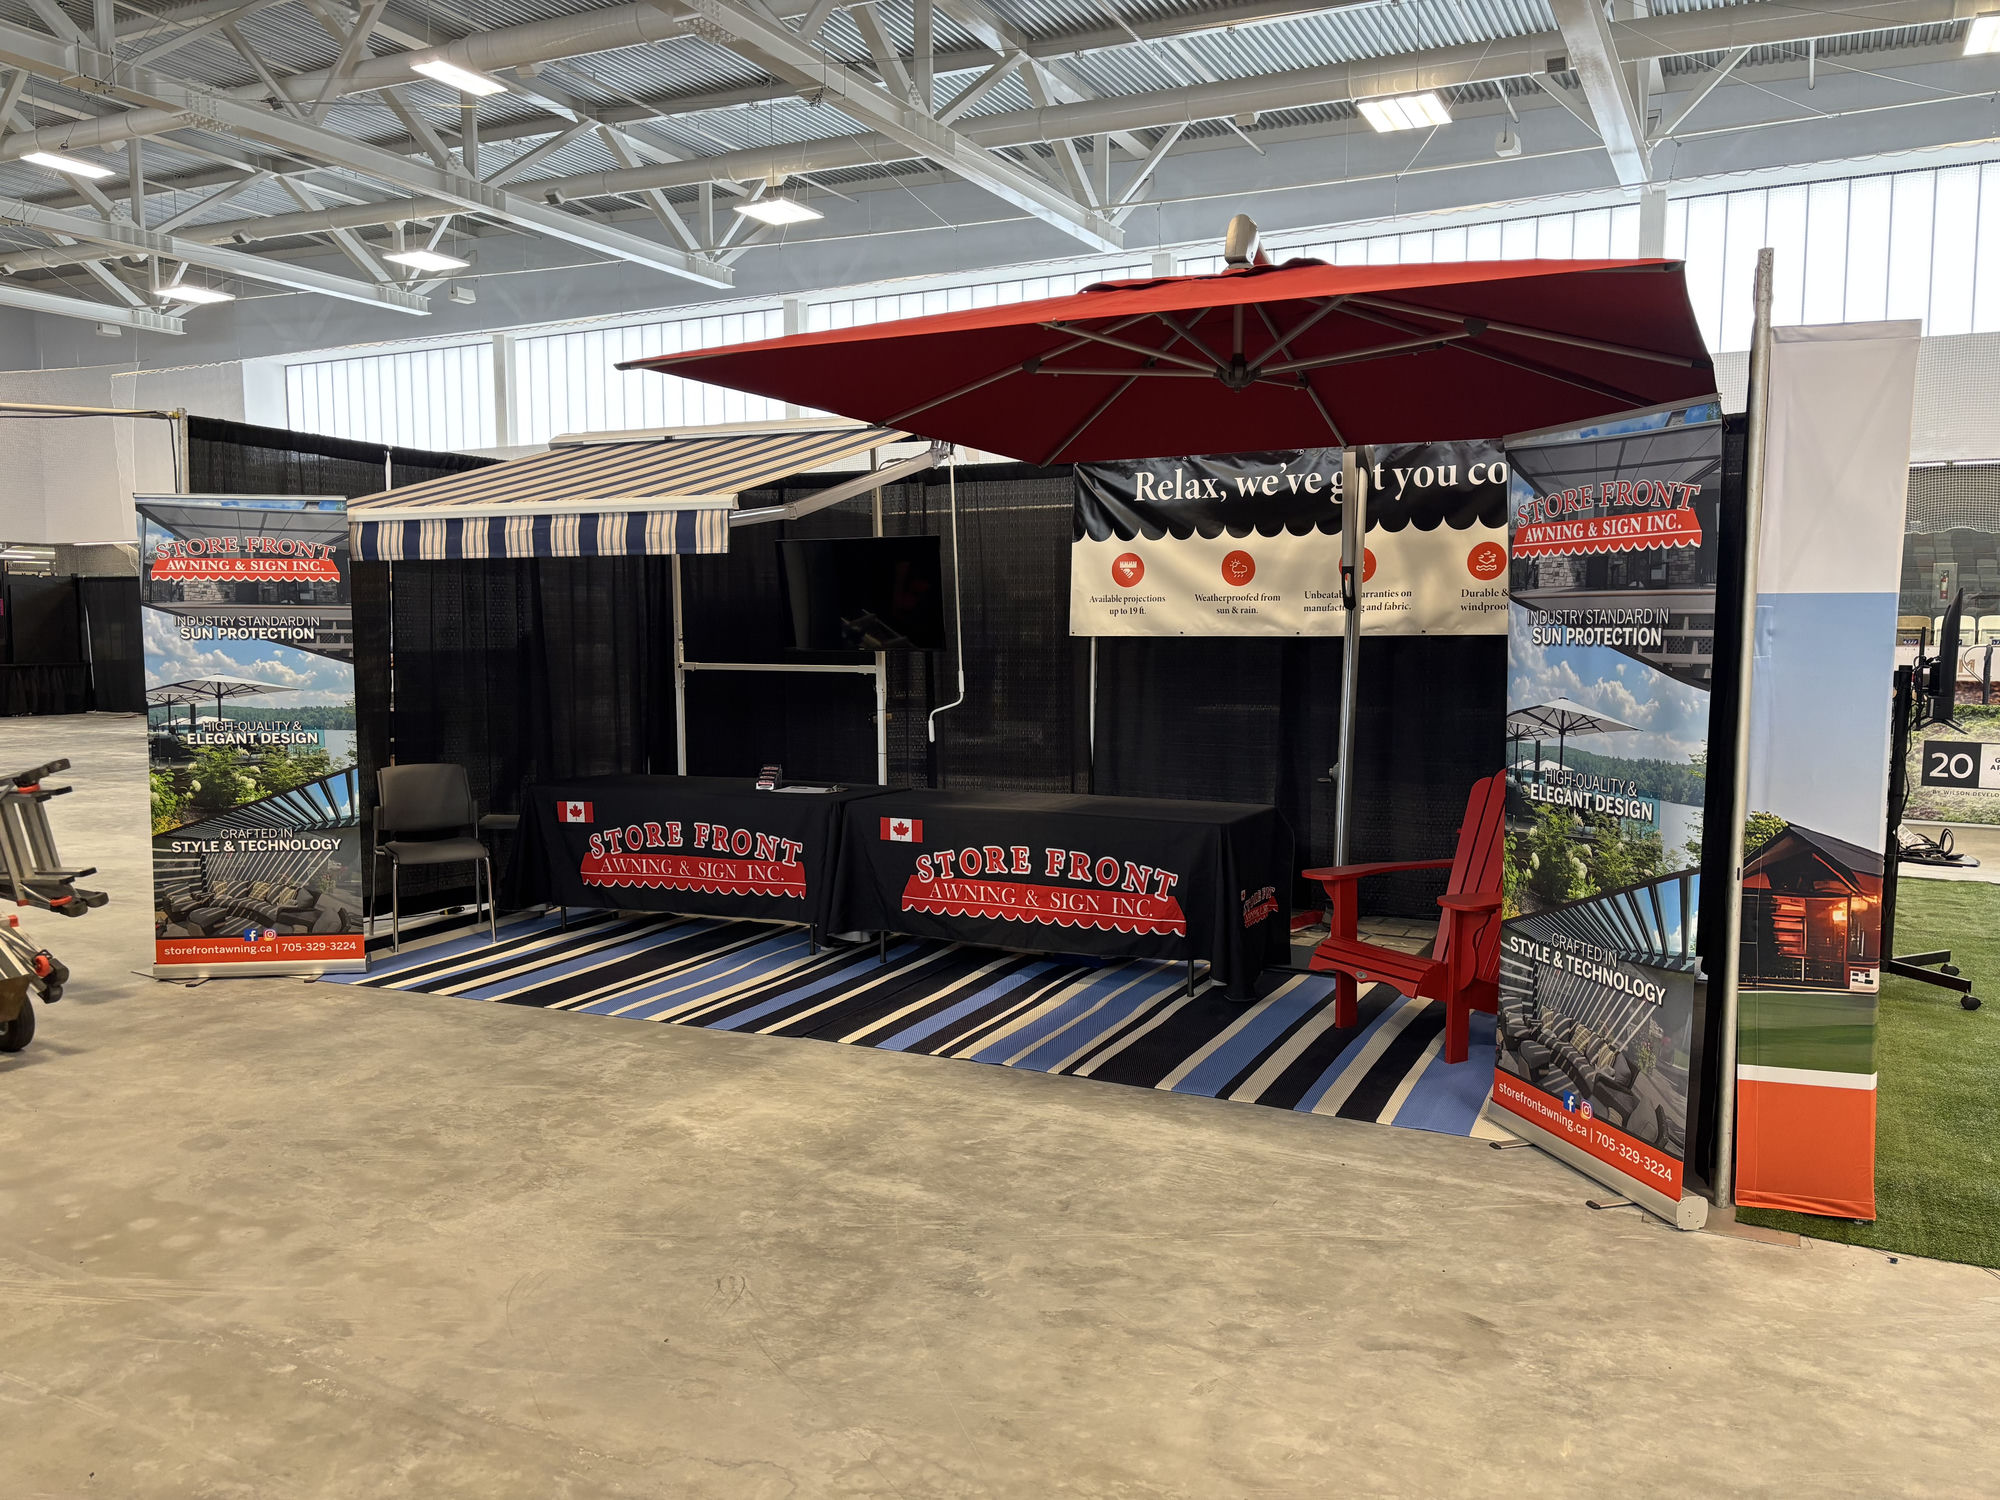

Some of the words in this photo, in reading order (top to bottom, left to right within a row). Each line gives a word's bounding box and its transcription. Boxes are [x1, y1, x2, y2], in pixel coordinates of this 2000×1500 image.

[1134, 468, 1227, 502] Relax,
[1330, 462, 1385, 504] gt
[1392, 464, 1458, 501] you
[1468, 461, 1507, 486] co
[1517, 484, 1594, 529] STORE
[1600, 479, 1701, 512] FRONT
[1524, 523, 1583, 543] AWNING
[1588, 523, 1598, 537] &
[1602, 518, 1643, 536] SIGN
[1646, 513, 1682, 531] INC.
[155, 536, 240, 560] STORE
[245, 536, 336, 561] FRONT
[166, 560, 230, 571] AWNING
[235, 561, 246, 571] &
[250, 560, 288, 571] SIGN
[292, 560, 325, 571] INC.
[1089, 595, 1122, 603] Available
[1123, 594, 1166, 605] projections
[1195, 593, 1259, 604] Weatherproofed
[1260, 593, 1281, 602] from
[1304, 590, 1344, 599] Unbeatab
[1361, 590, 1399, 599] arranties
[1461, 588, 1499, 598] Durable
[1501, 588, 1509, 597] &
[1109, 608, 1119, 617] up
[1129, 607, 1138, 615] 19
[1139, 607, 1147, 615] ft.
[1366, 602, 1382, 611] and
[1384, 601, 1412, 611] fabric.
[174, 615, 236, 627] INDUSTRY
[239, 615, 305, 626] STANDARD
[307, 615, 320, 626] IN
[1527, 608, 1584, 625] INDUSTRY
[1586, 608, 1653, 625] STANDARD
[1656, 608, 1669, 624] IN
[180, 628, 213, 640] SUN
[217, 628, 315, 639] PROTECTION
[1532, 628, 1563, 645] SUN
[1566, 628, 1662, 646] PROTECTION
[202, 721, 289, 732] HIGH-QUALITY
[293, 721, 302, 732] &
[187, 733, 256, 745] ELEGANT
[261, 732, 318, 744] DESIGN
[1929, 752, 1973, 779] 20
[1545, 768, 1626, 795] HIGH-QUALITY
[1628, 781, 1637, 797] &
[1530, 783, 1592, 810] ELEGANT
[1596, 794, 1653, 821] DESIGN
[220, 829, 278, 840] CRAFTED
[279, 829, 293, 839] IN
[172, 841, 220, 853] STYLE
[223, 841, 236, 852] &
[238, 839, 341, 851] TECHNOLOGY
[589, 822, 683, 859] STORE
[693, 823, 802, 867] FRONT
[600, 857, 672, 875] AWNING
[679, 862, 691, 876] &
[698, 862, 737, 879] SIGN
[748, 864, 784, 881] INC.
[915, 845, 1031, 883] STORE
[1045, 847, 1178, 902] FRONT
[929, 883, 1016, 905] AWNING
[1025, 889, 1039, 907] &
[1050, 892, 1100, 913] SIGN
[1112, 897, 1153, 918] INC.
[164, 943, 272, 956] storefrontawning.ca
[282, 942, 356, 952] 705-329-3224
[1551, 933, 1603, 962] CRAFTED
[1604, 950, 1618, 967] IN
[1510, 936, 1550, 964] STYLE
[1553, 952, 1563, 969] &
[1565, 954, 1666, 1006] TECHNOLOGY
[1499, 1082, 1587, 1137] storefrontawning.ca
[1596, 1130, 1673, 1182] 705-329-3224
